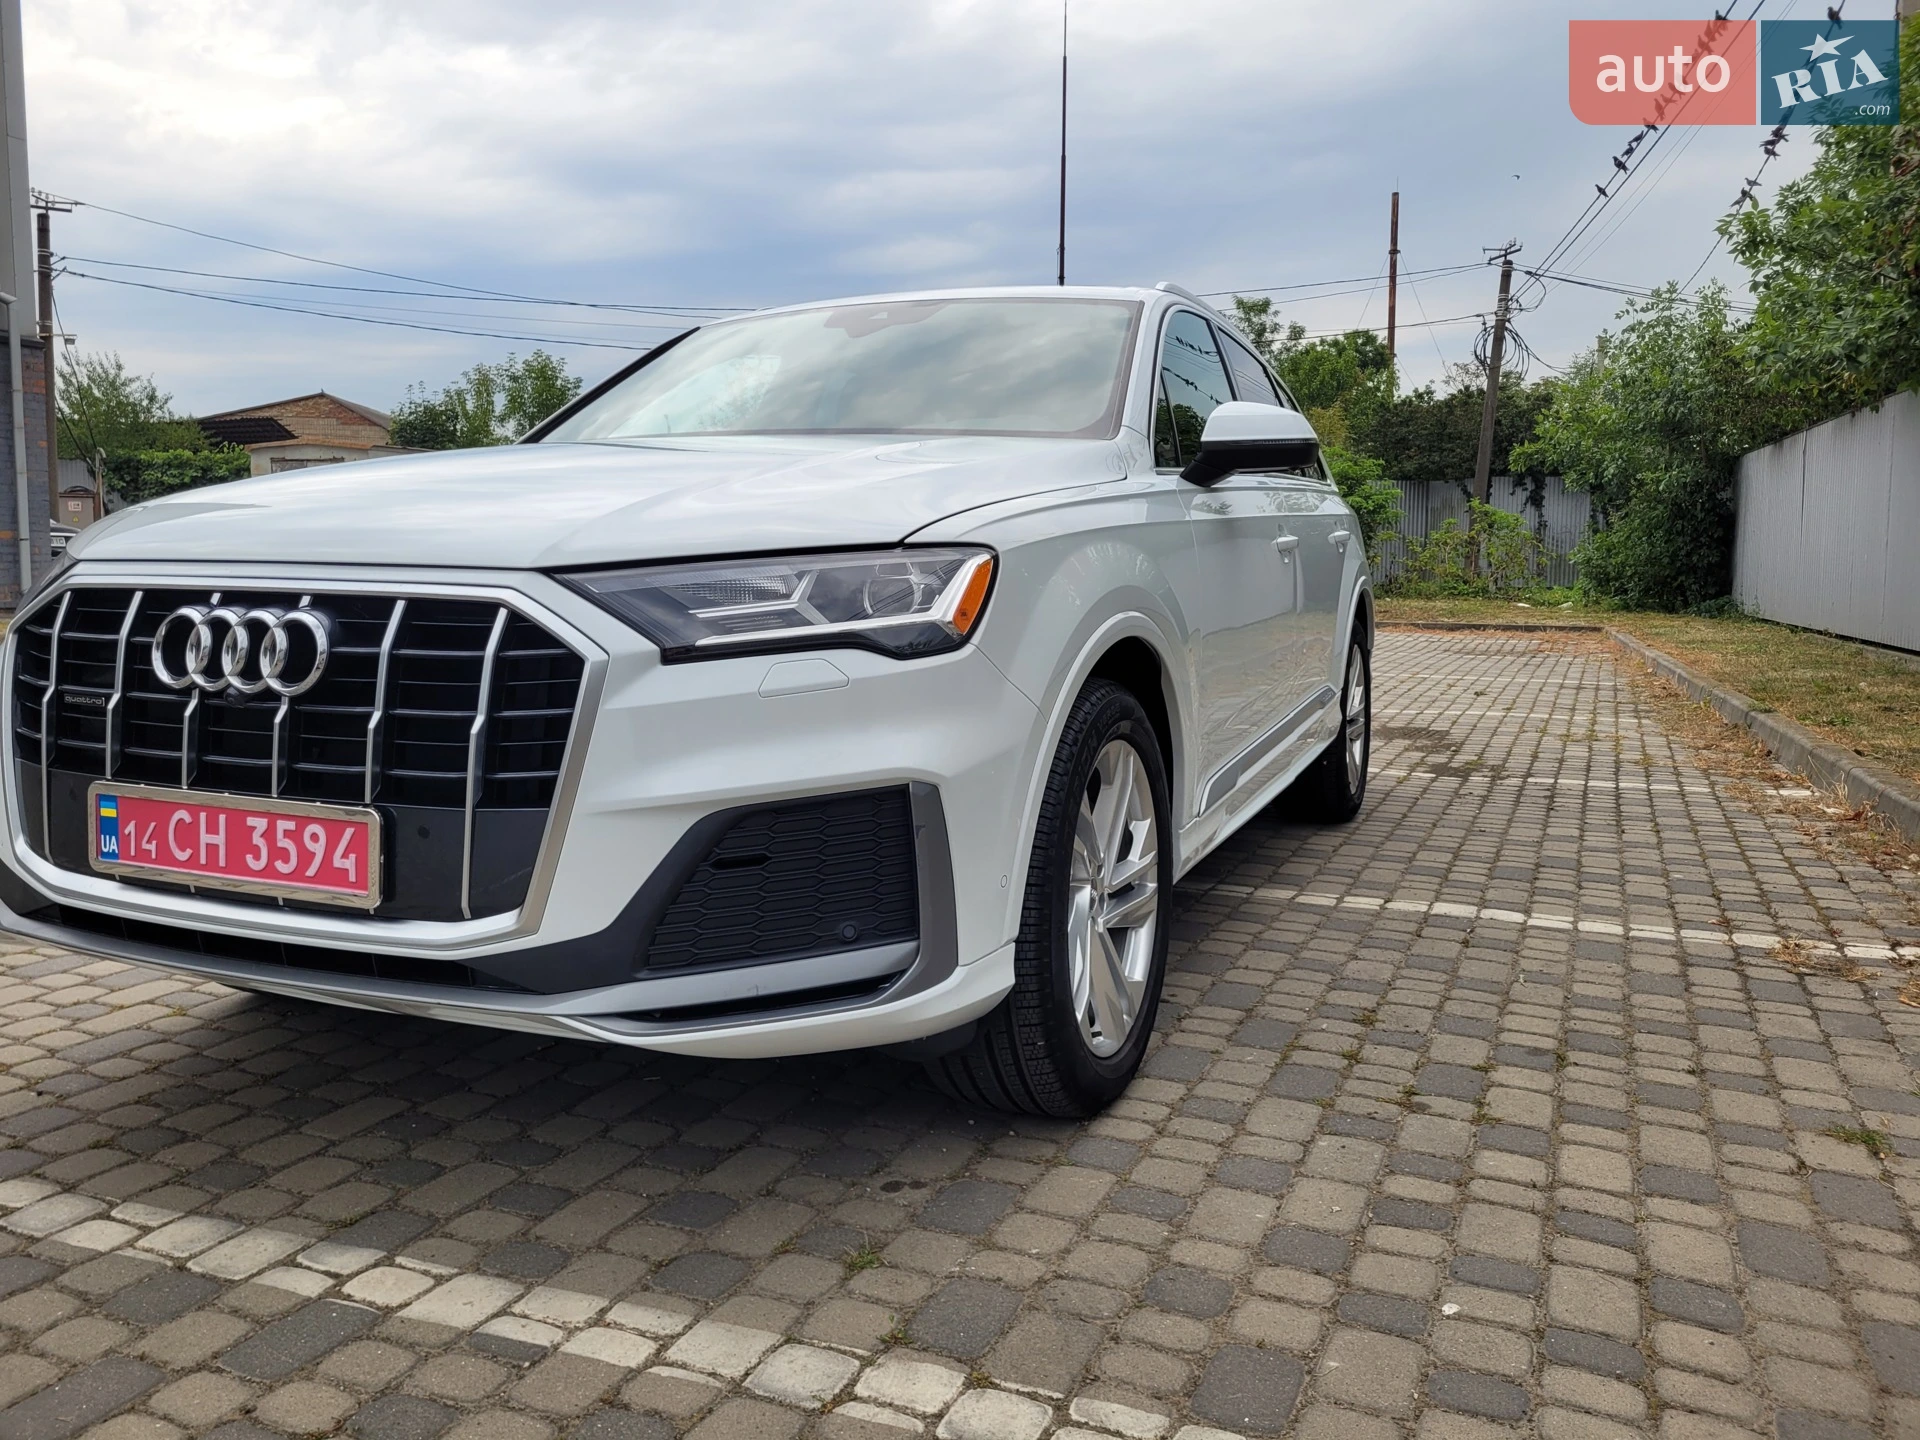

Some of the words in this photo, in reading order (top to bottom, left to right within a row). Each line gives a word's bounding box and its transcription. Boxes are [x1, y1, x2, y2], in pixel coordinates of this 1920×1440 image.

[65, 695, 103, 704] quattro
[101, 834, 118, 854] UA
[124, 820, 157, 860] 14
[168, 809, 226, 868] CH
[246, 817, 357, 883] 3594
